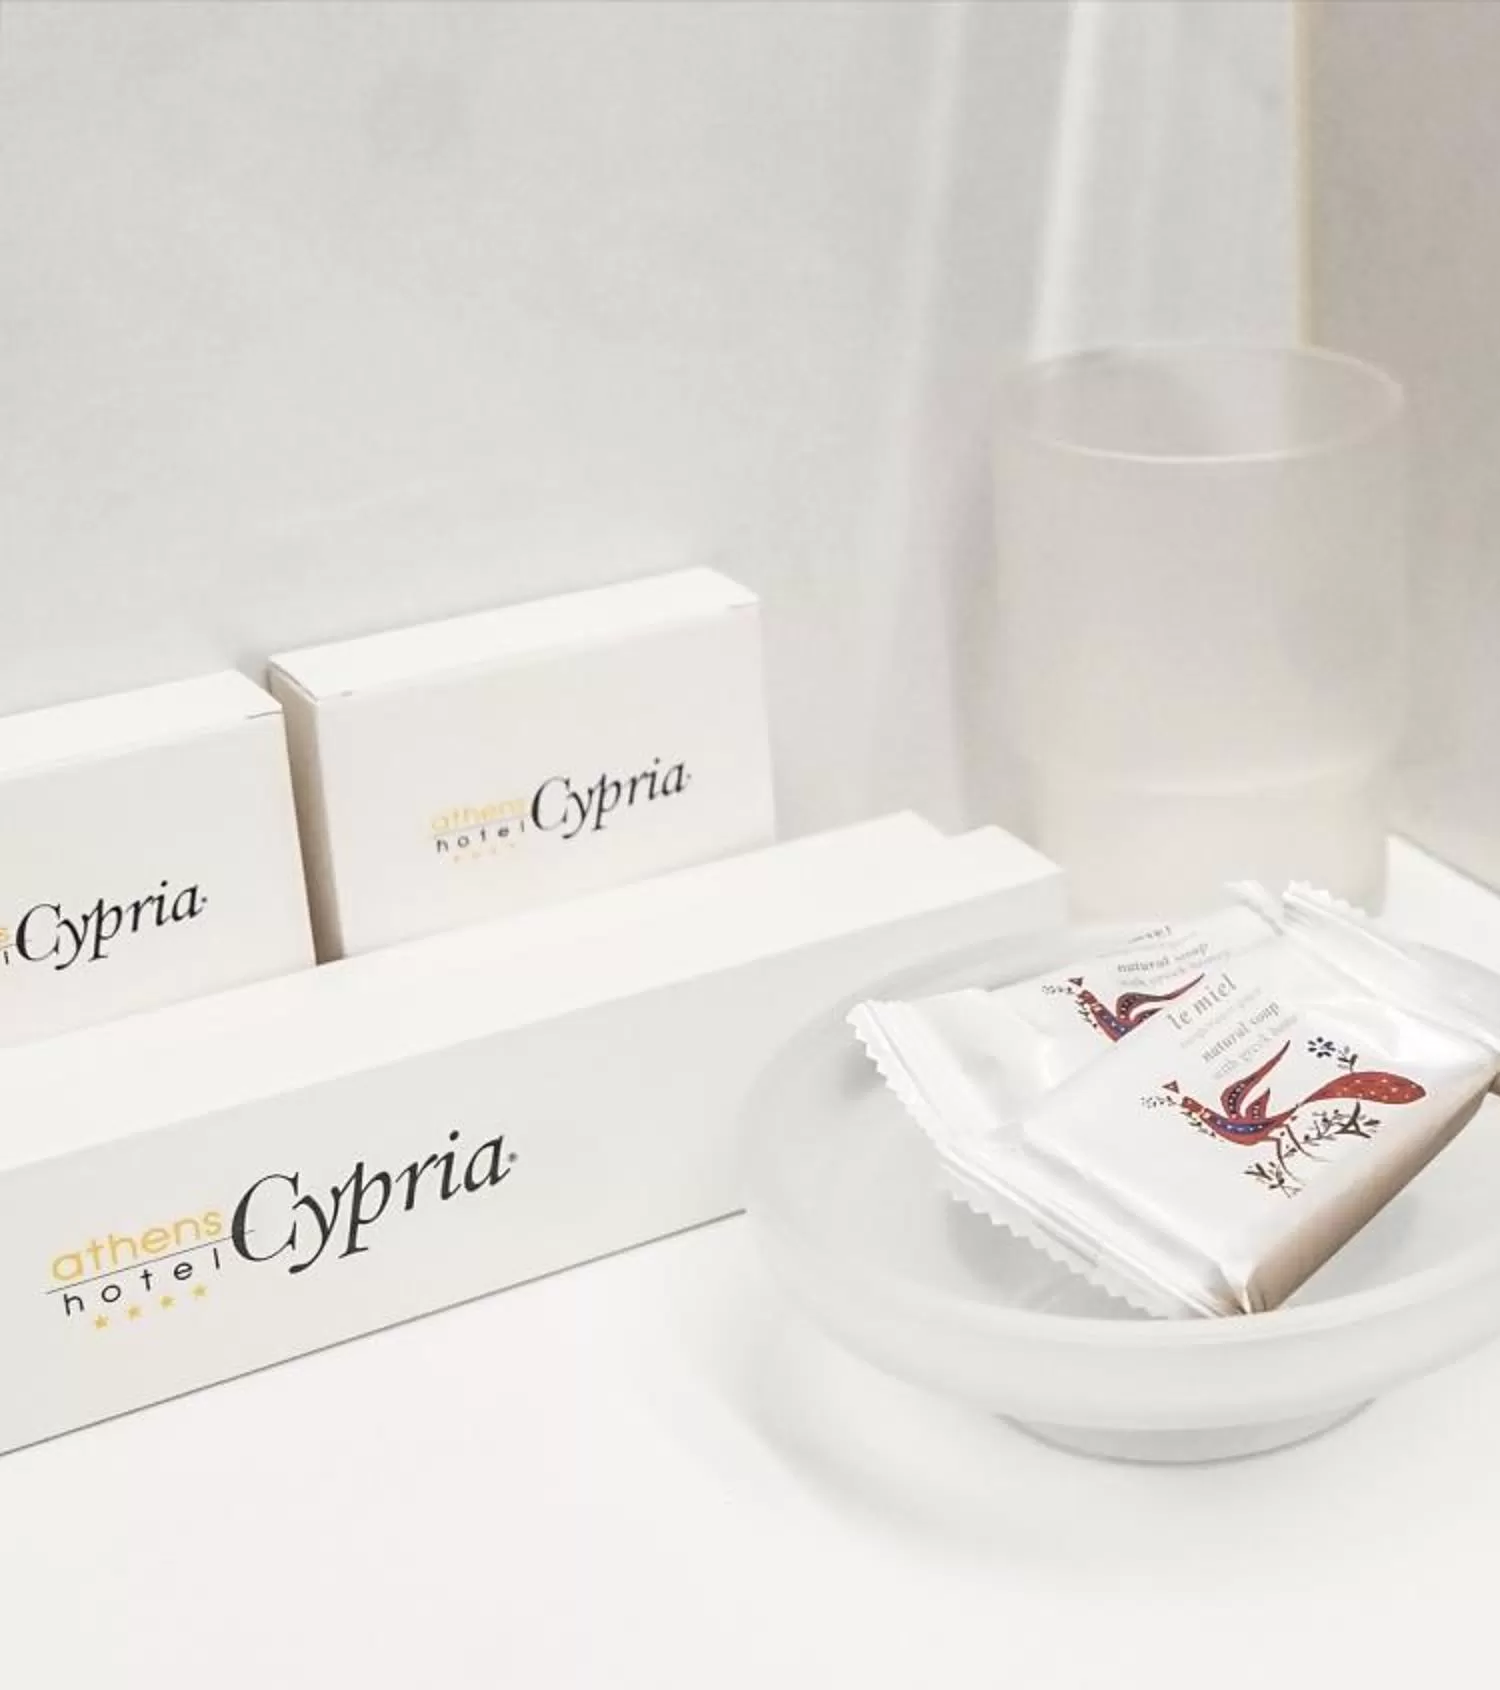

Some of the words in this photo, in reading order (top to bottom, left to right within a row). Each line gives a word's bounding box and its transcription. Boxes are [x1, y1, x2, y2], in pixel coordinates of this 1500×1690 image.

[431, 797, 526, 832] athens
[531, 757, 688, 839] Cypria
[436, 819, 525, 852] hotel
[15, 880, 205, 970] Cypria
[1165, 1009, 1190, 1030] le
[1193, 973, 1237, 1015] miel
[1202, 1021, 1249, 1063] natural
[231, 1130, 513, 1274] Cypria
[51, 1210, 223, 1281] athens
[63, 1247, 221, 1316] hotel
